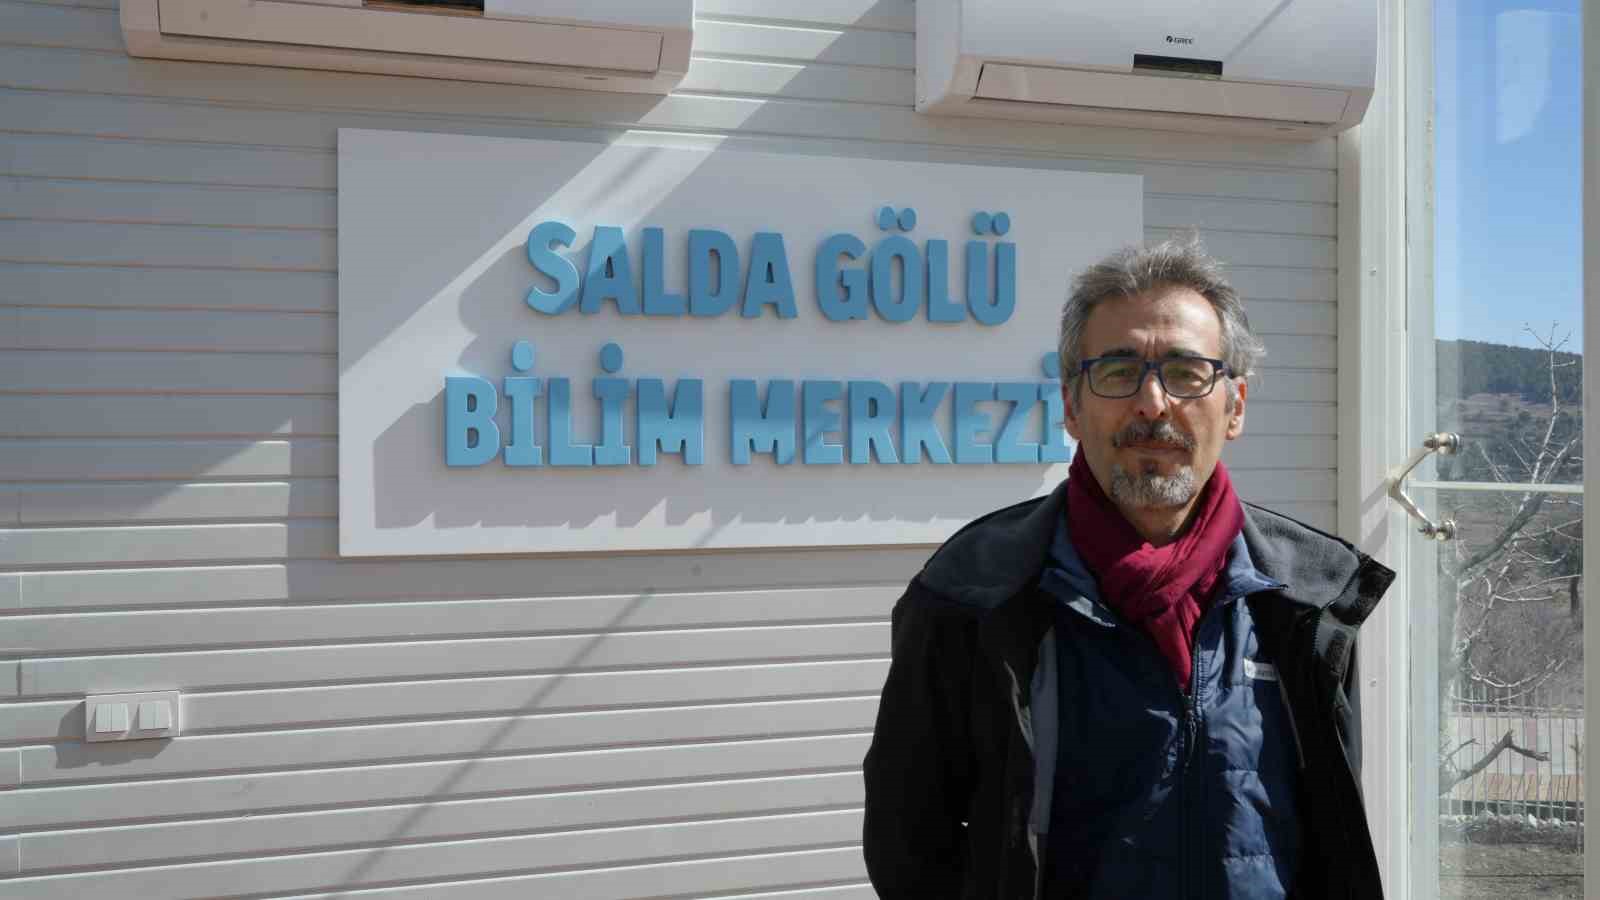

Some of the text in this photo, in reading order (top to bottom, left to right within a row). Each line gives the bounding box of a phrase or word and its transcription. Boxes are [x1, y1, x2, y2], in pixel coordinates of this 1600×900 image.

[525, 205, 1017, 326] SALDA GÖLÜ
[445, 340, 1072, 467] BİLİM MERKEZİ
